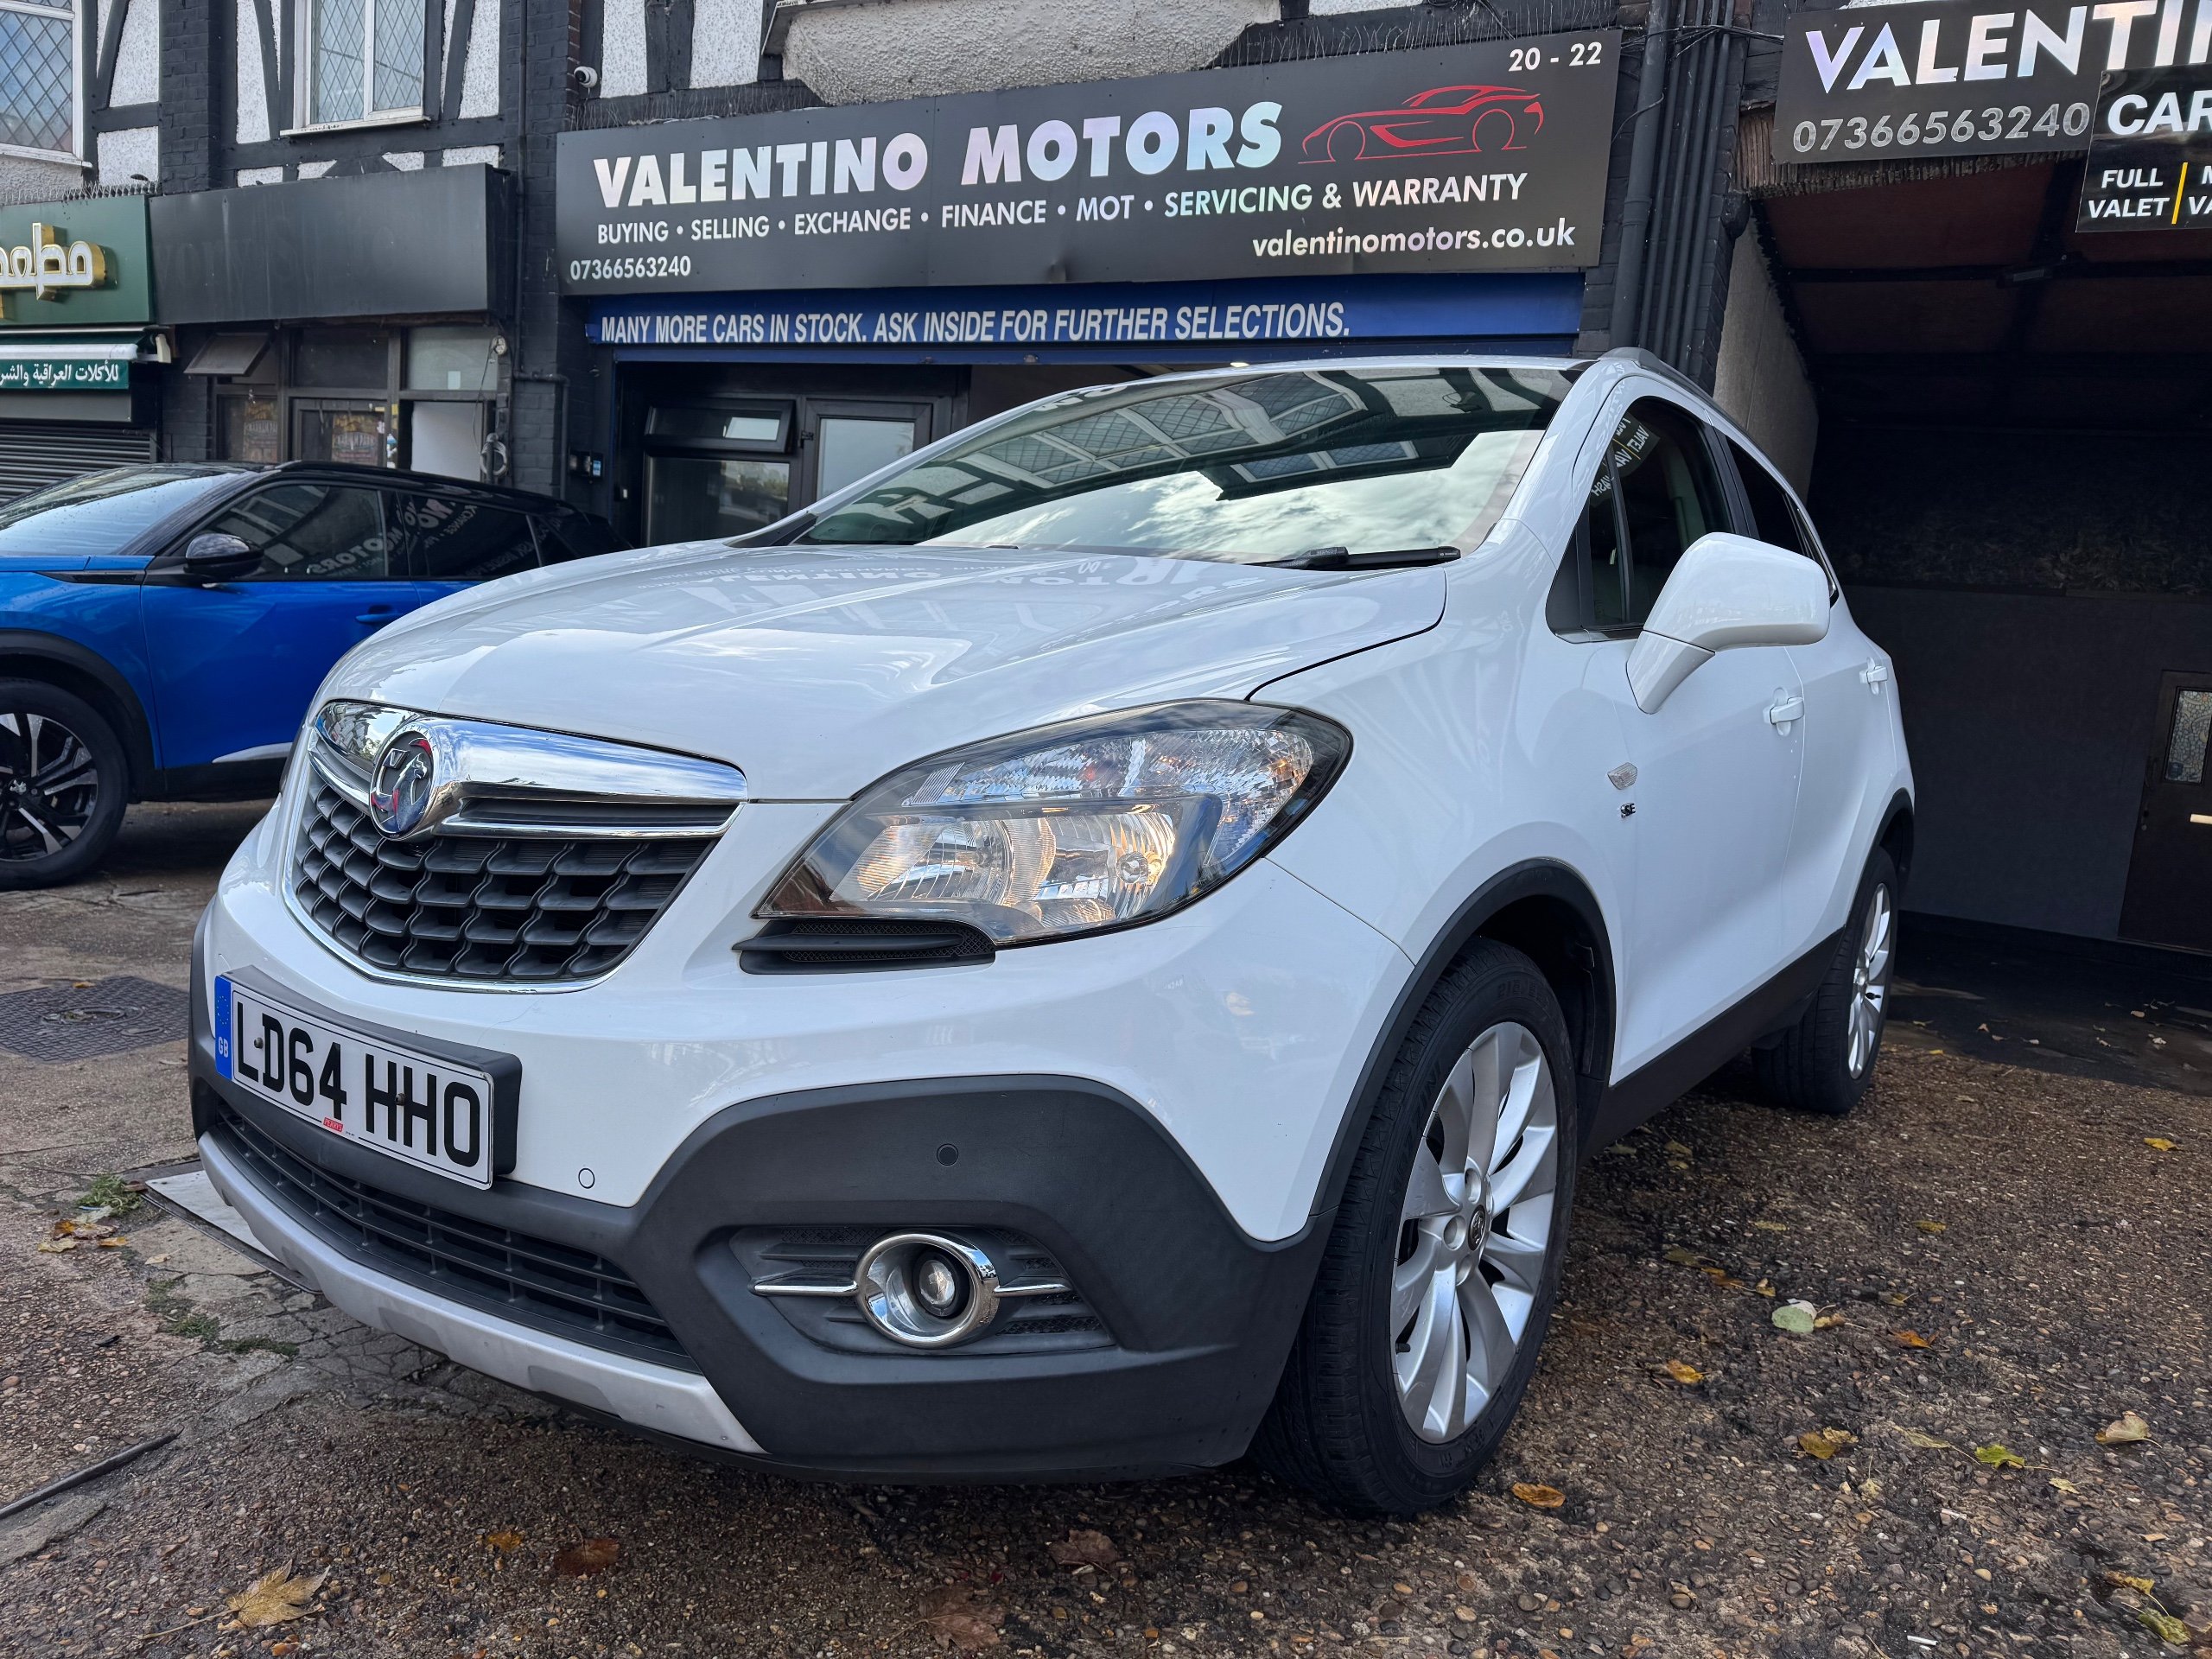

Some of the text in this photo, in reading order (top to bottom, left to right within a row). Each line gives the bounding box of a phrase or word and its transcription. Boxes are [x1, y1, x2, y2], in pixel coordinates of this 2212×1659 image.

[1509, 48, 1540, 72] 20
[1569, 41, 1602, 66] 22
[1793, 103, 2089, 152] 07366563240
[594, 101, 1282, 208] VALENTINO MOTORS
[2101, 168, 2163, 188] FULL
[597, 173, 1528, 245] BUYING SELLING EXCHANGE FINANCE MOT SERVICING & WARRANTY
[2088, 198, 2170, 218] VALET
[1253, 218, 1575, 257] valentinomotors.co.uk
[569, 255, 691, 281] 07366563240
[601, 302, 1350, 343] MANY MORE CARS IN STOCK. ASK INSIDE FOR FURTHER SELECTIONS.
[33, 364, 72, 388] العراقية
[218, 1036, 229, 1058] GB
[237, 1001, 480, 1167] LD64 HHO
[324, 1119, 343, 1132] PERRYS
